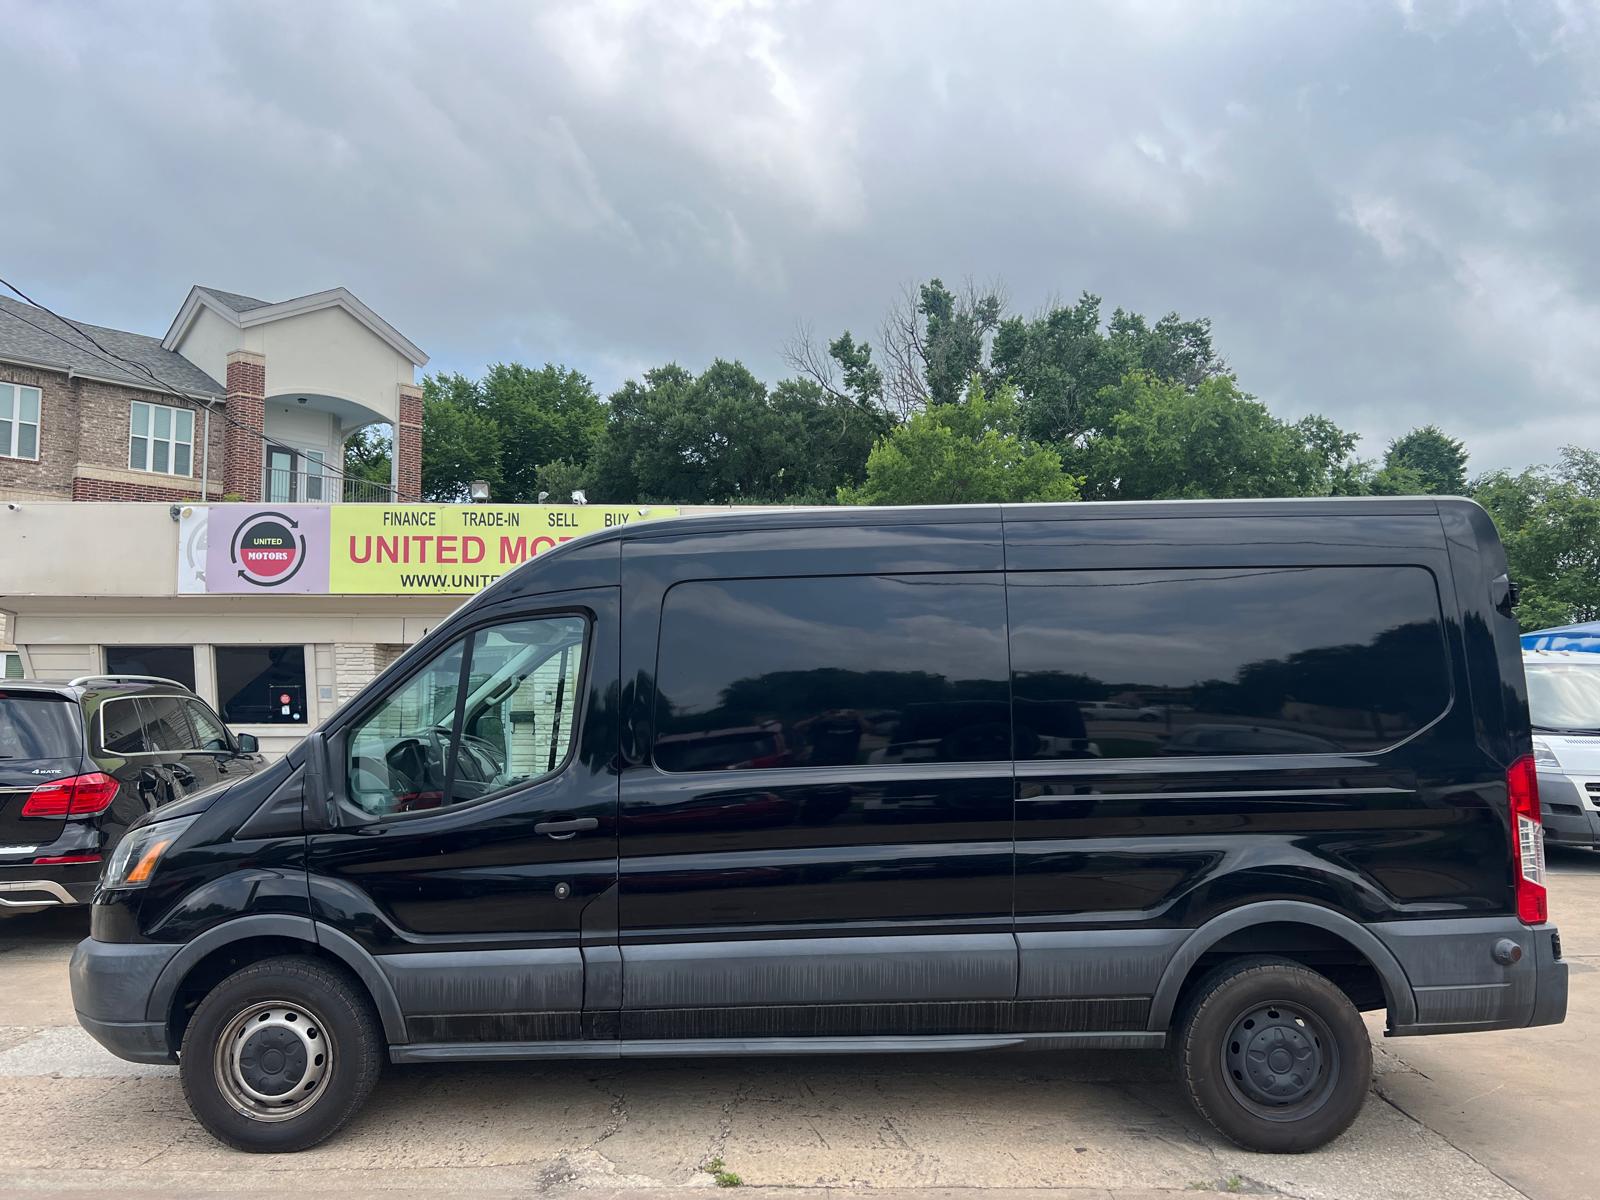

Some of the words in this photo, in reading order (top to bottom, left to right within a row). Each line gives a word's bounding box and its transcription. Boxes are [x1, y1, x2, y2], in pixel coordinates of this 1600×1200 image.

[383, 511, 436, 526] FINANCE
[462, 512, 520, 527] TRADE-IN
[548, 513, 578, 527] SELL
[604, 513, 630, 528] BUY
[253, 537, 283, 546] UNITED
[349, 535, 486, 564] UNITED
[247, 552, 288, 562] MOTORS
